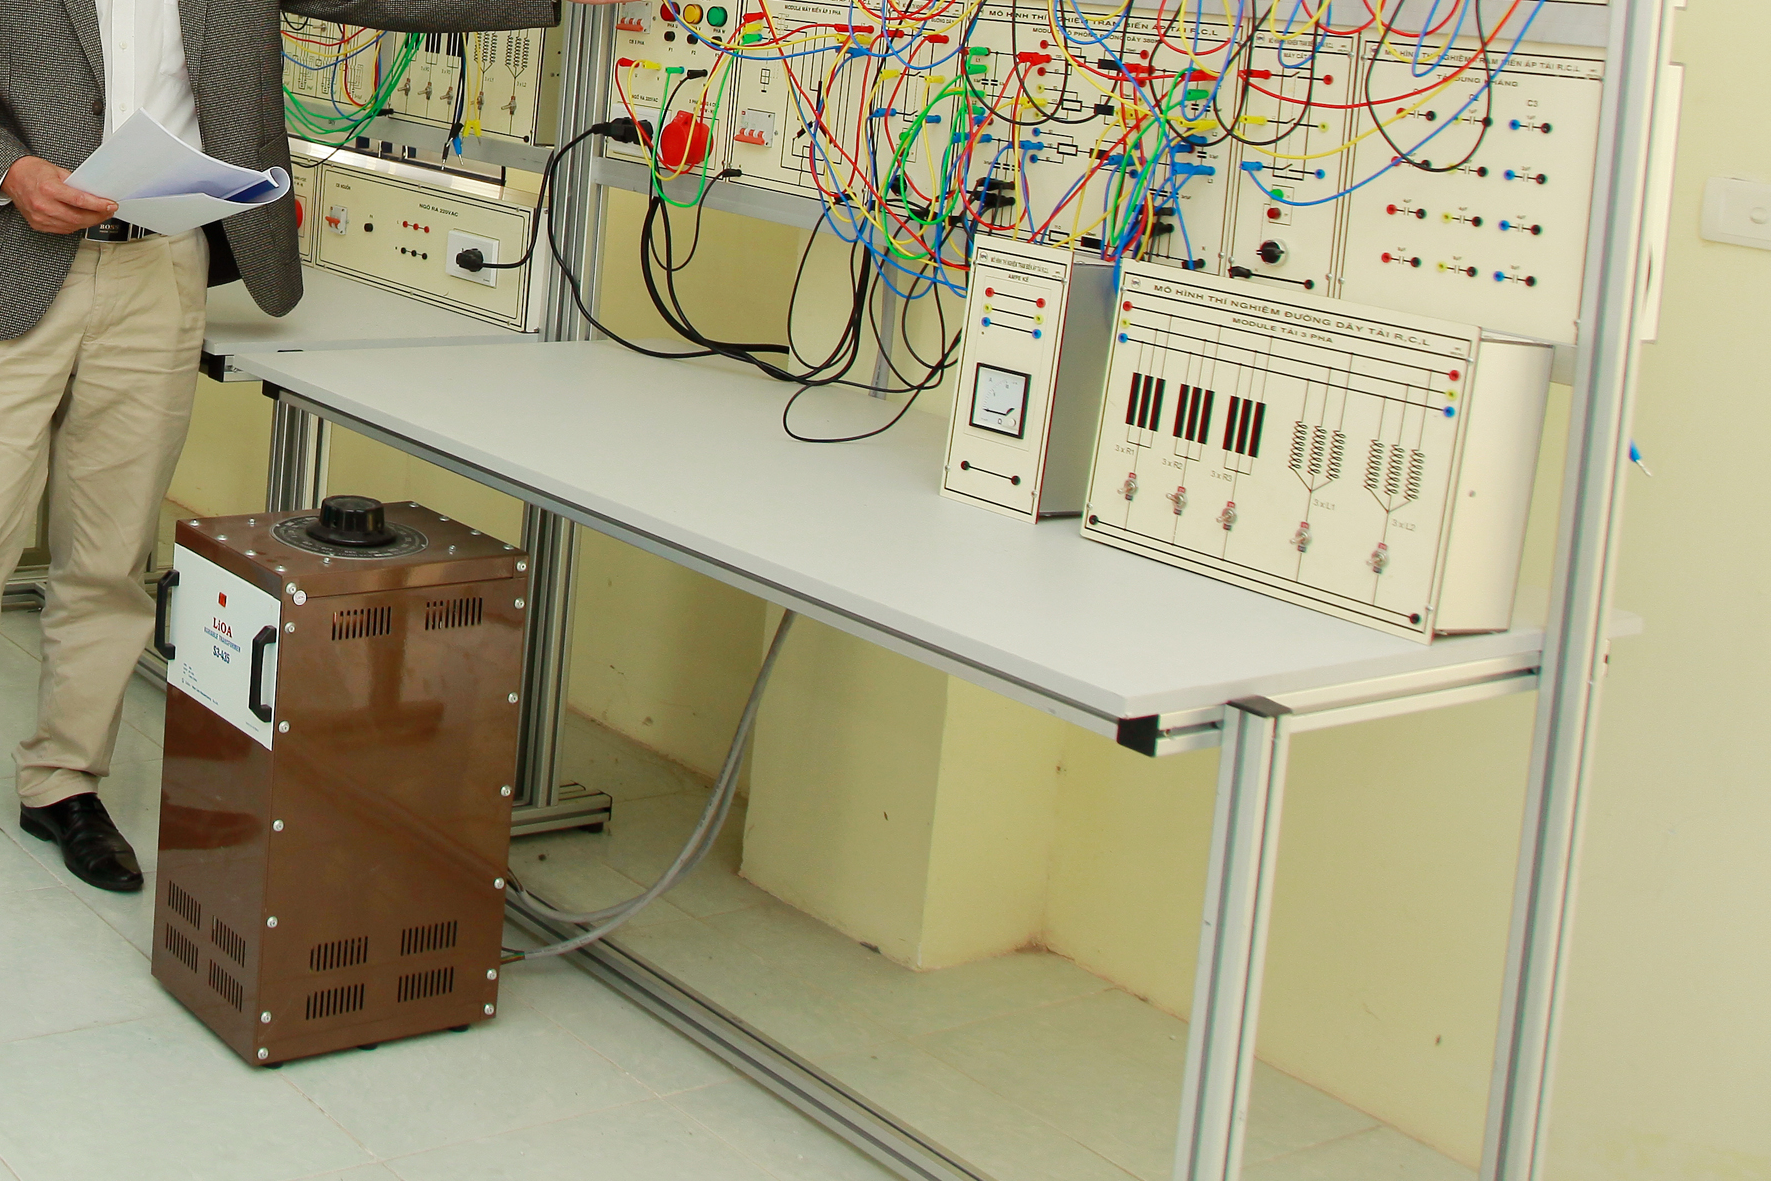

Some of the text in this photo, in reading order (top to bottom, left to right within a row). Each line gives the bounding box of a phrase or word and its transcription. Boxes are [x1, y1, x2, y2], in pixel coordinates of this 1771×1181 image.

[989, 9, 1003, 17] MÔ
[1524, 60, 1537, 68] ÁP
[1527, 99, 1539, 108] C3
[440, 207, 459, 217] 220VAC
[1154, 284, 1430, 347] MÔ HÌNH THÍ NGHIỆM ĐƯỜNG DÂY TẢI R.C.L
[1232, 317, 1277, 332] MODULE
[1280, 327, 1298, 336] TẢI
[1310, 333, 1334, 344] PHA
[213, 616, 233, 638] LiOA
